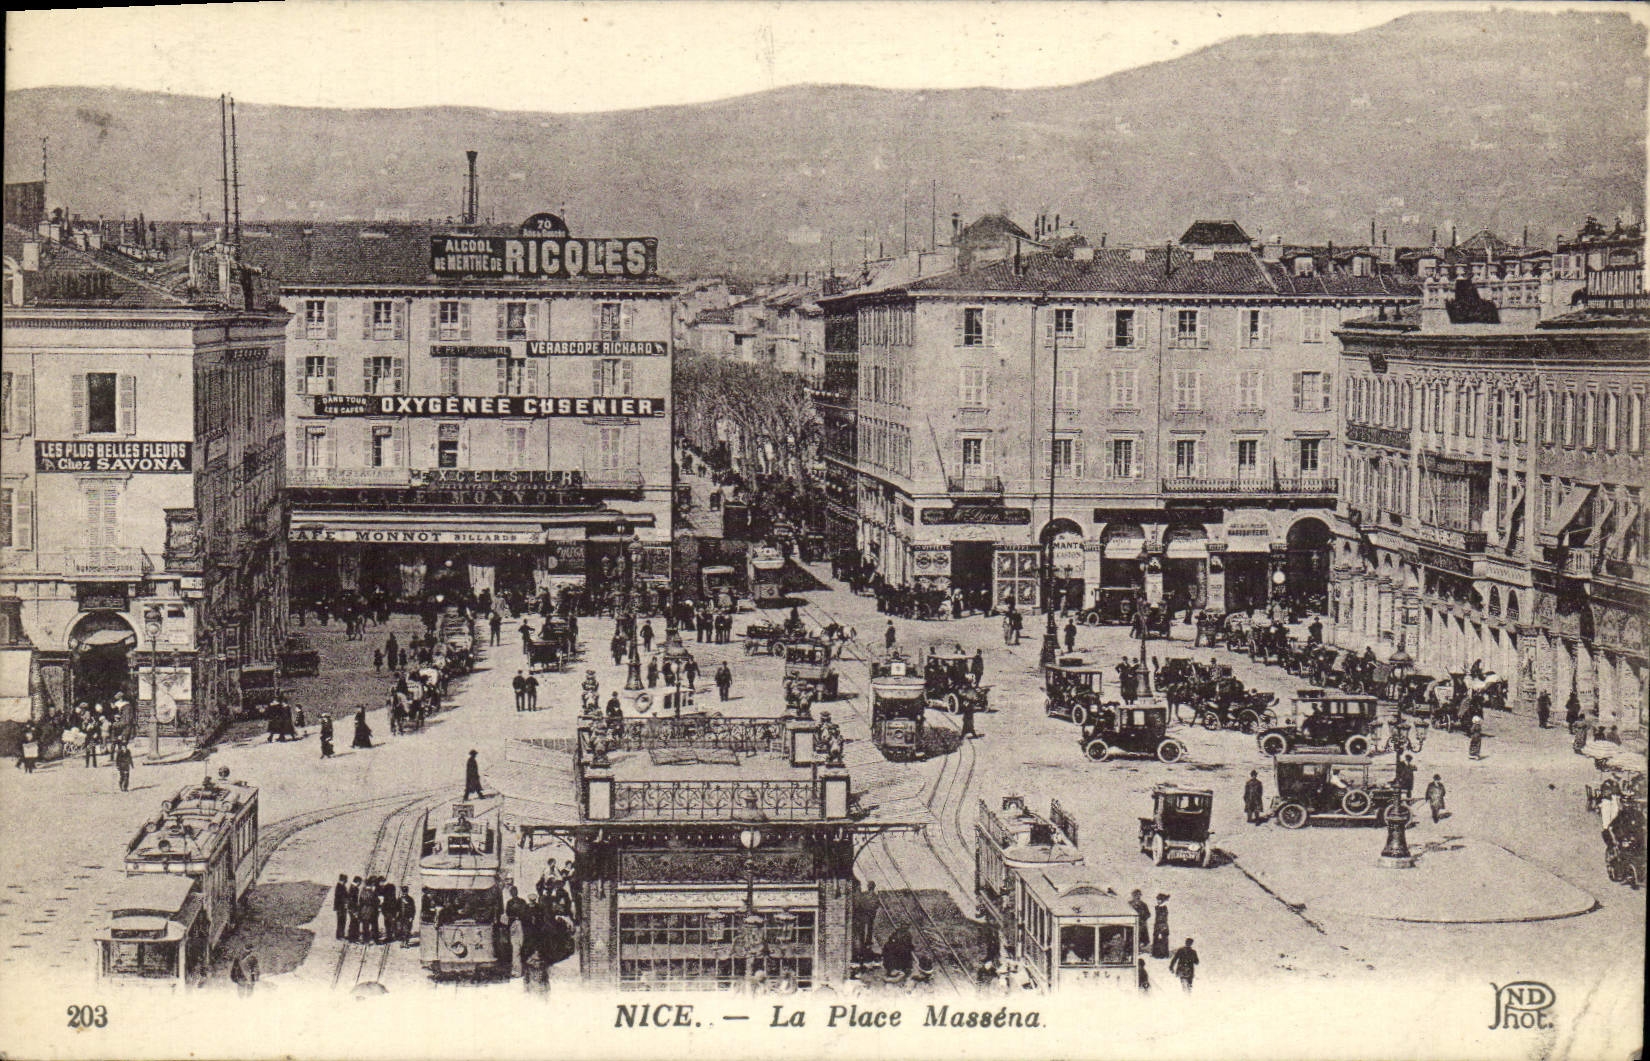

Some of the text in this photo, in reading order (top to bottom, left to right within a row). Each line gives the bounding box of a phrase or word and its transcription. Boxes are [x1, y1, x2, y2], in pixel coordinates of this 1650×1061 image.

[445, 239, 493, 253] ALCOOL
[433, 254, 503, 272] DE MENTHE DE
[602, 342, 652, 355] RICHARD
[523, 397, 653, 416] CUSENIER
[41, 442, 186, 458] LES PLUS BELLES FLEURS
[57, 457, 185, 470] Chez SAVONA
[355, 530, 442, 542] MONNOT
